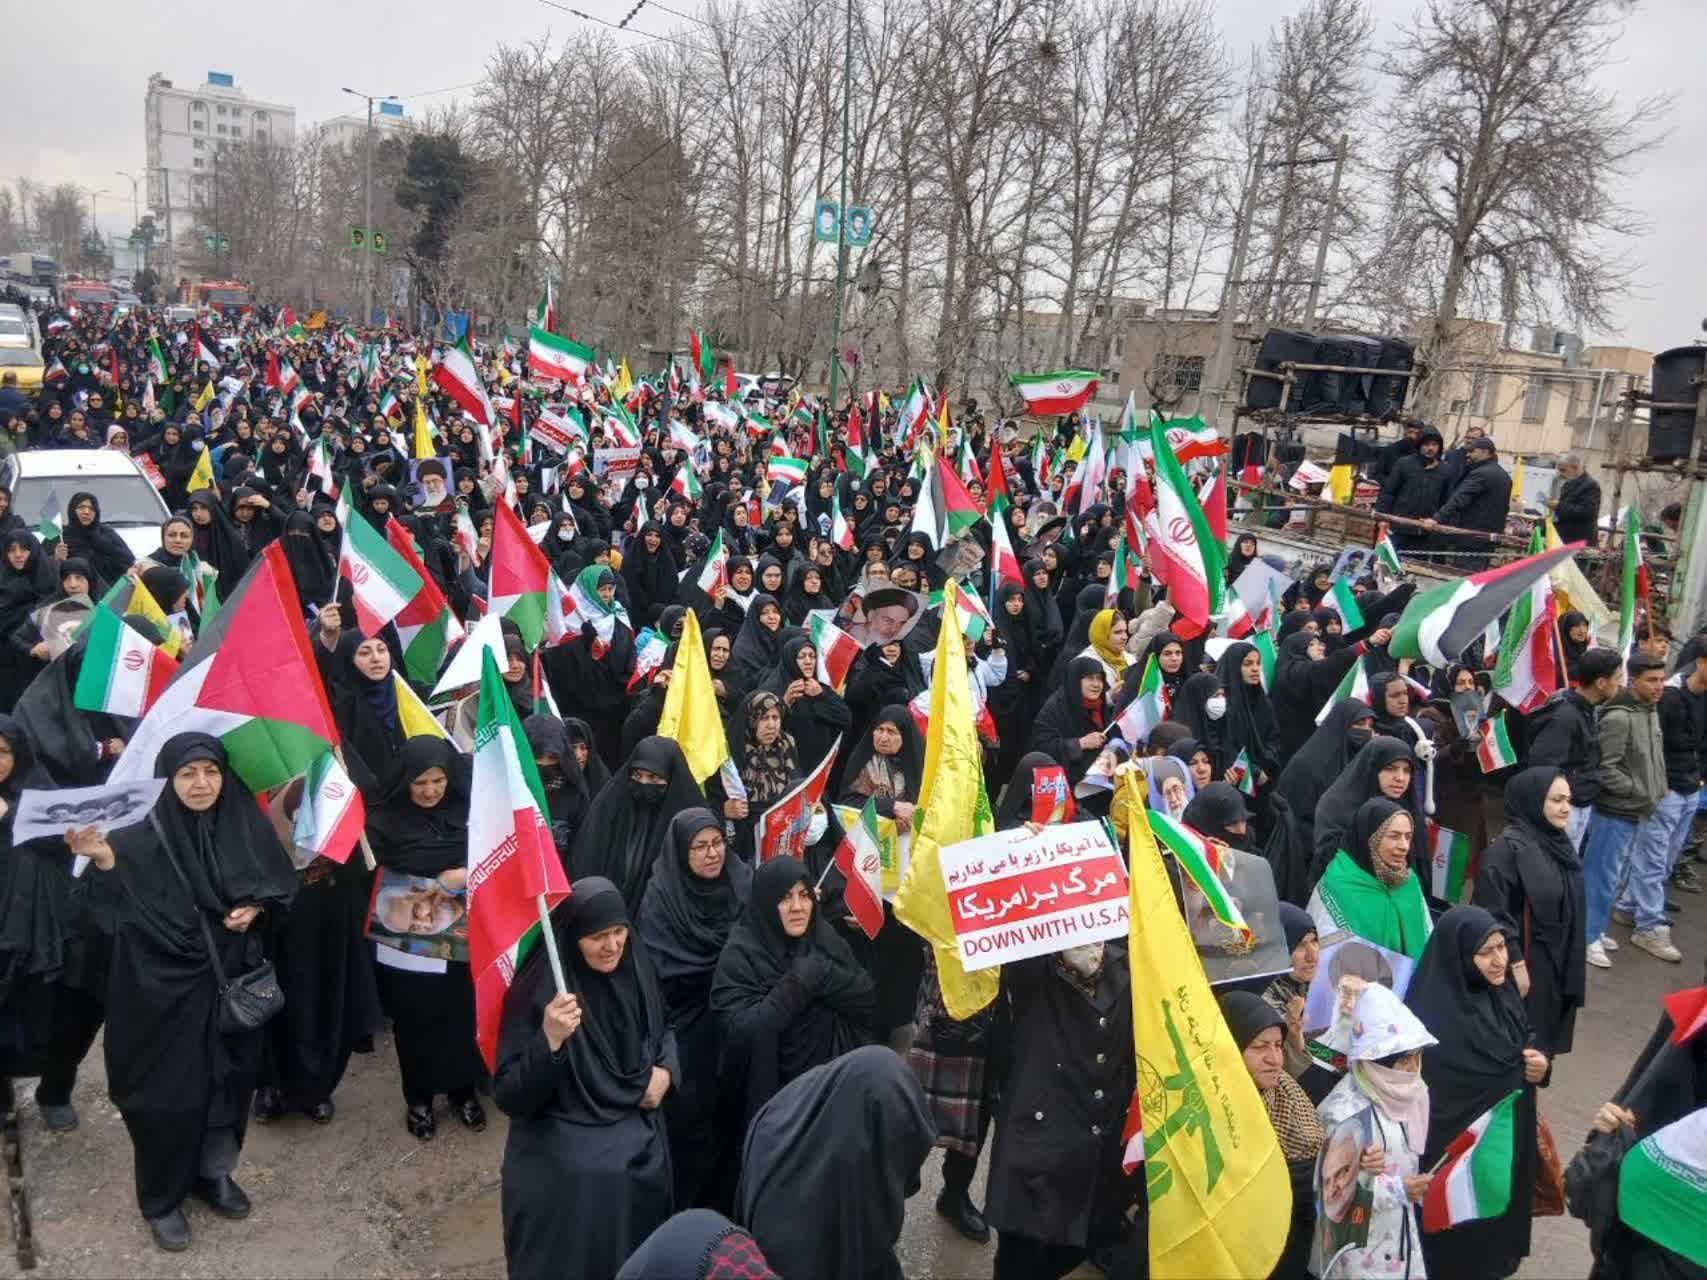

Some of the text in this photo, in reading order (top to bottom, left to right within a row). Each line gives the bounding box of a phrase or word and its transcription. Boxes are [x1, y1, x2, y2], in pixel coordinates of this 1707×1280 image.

[1022, 848, 1041, 867] زیر
[1041, 845, 1056, 862] را
[989, 859, 1007, 875] می
[1062, 866, 1118, 896] مرگ
[963, 927, 1026, 957] DOWN
[1027, 916, 1078, 942] WITH
